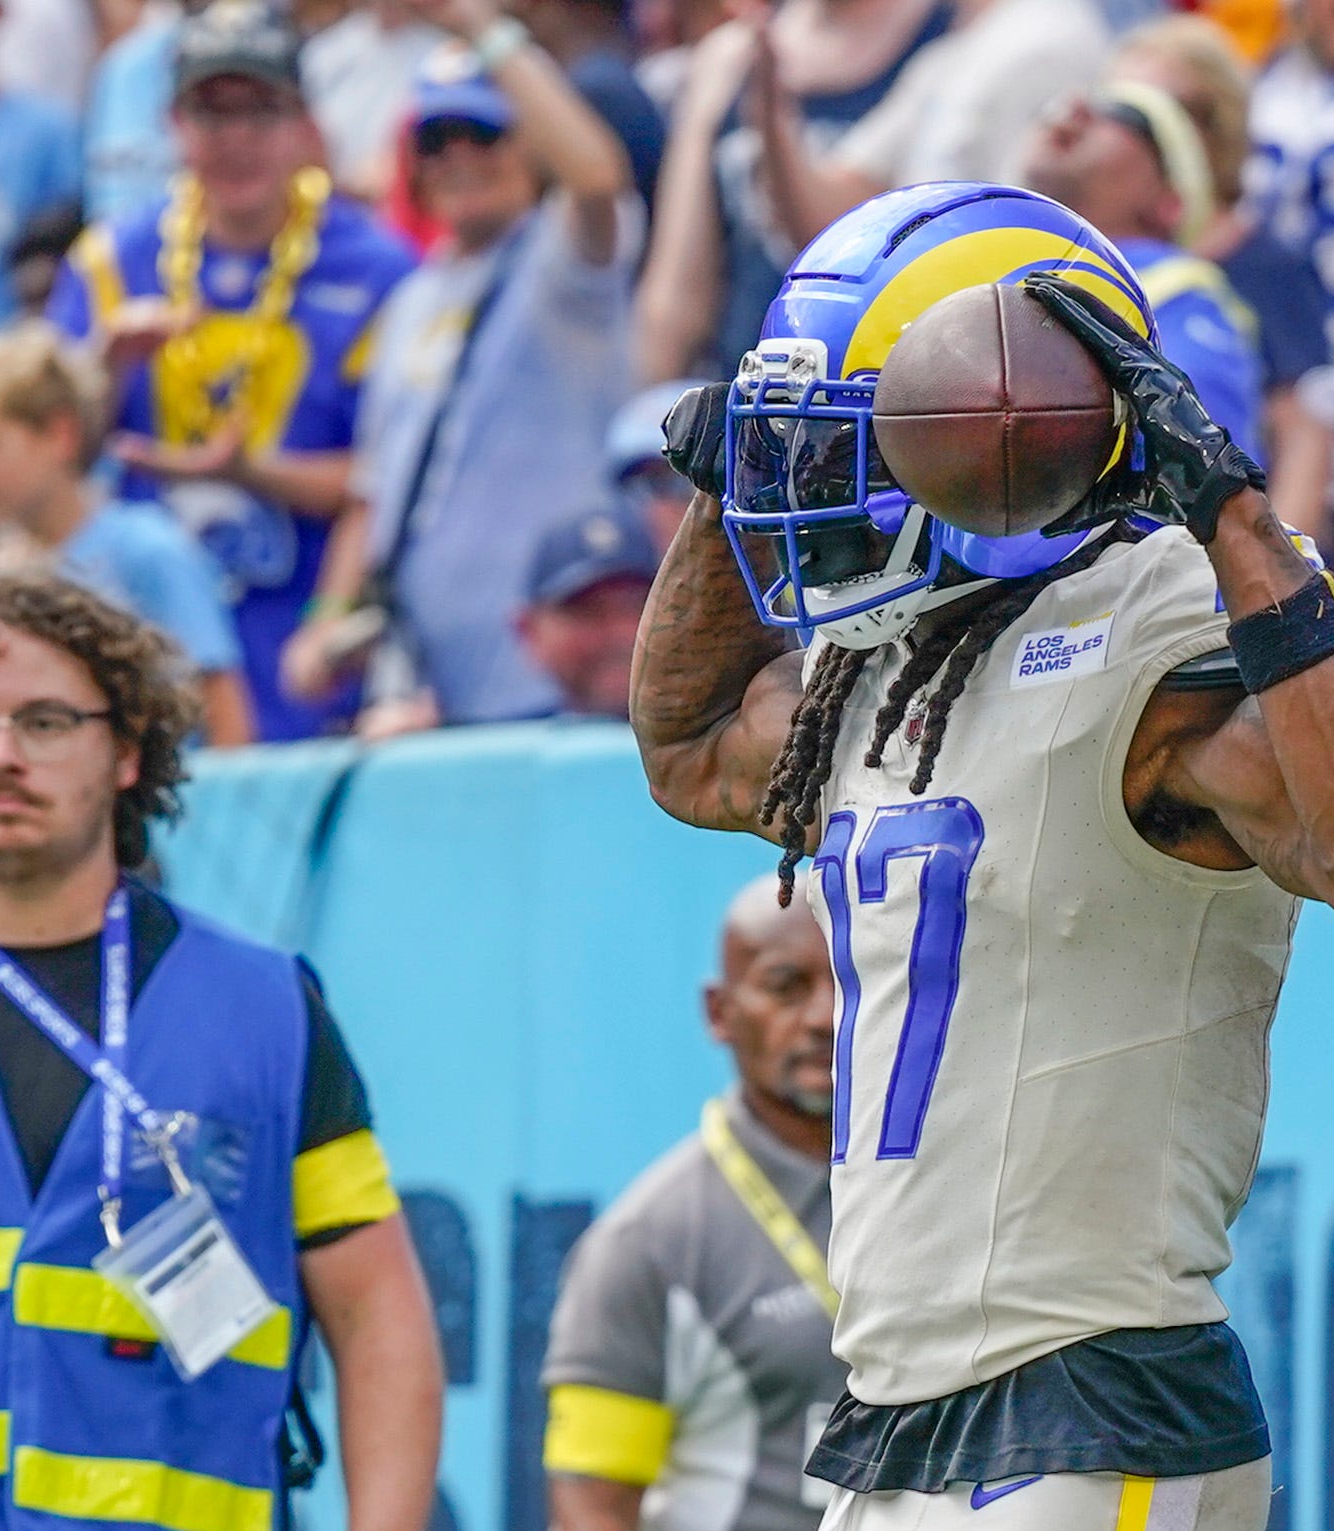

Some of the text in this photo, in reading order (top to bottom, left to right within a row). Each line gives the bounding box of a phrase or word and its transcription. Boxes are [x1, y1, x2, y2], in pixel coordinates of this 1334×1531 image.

[1020, 634, 1104, 664] ANGELES
[1025, 634, 1065, 651] LOS
[1018, 656, 1073, 677] RAMS
[811, 796, 985, 1166] 17
